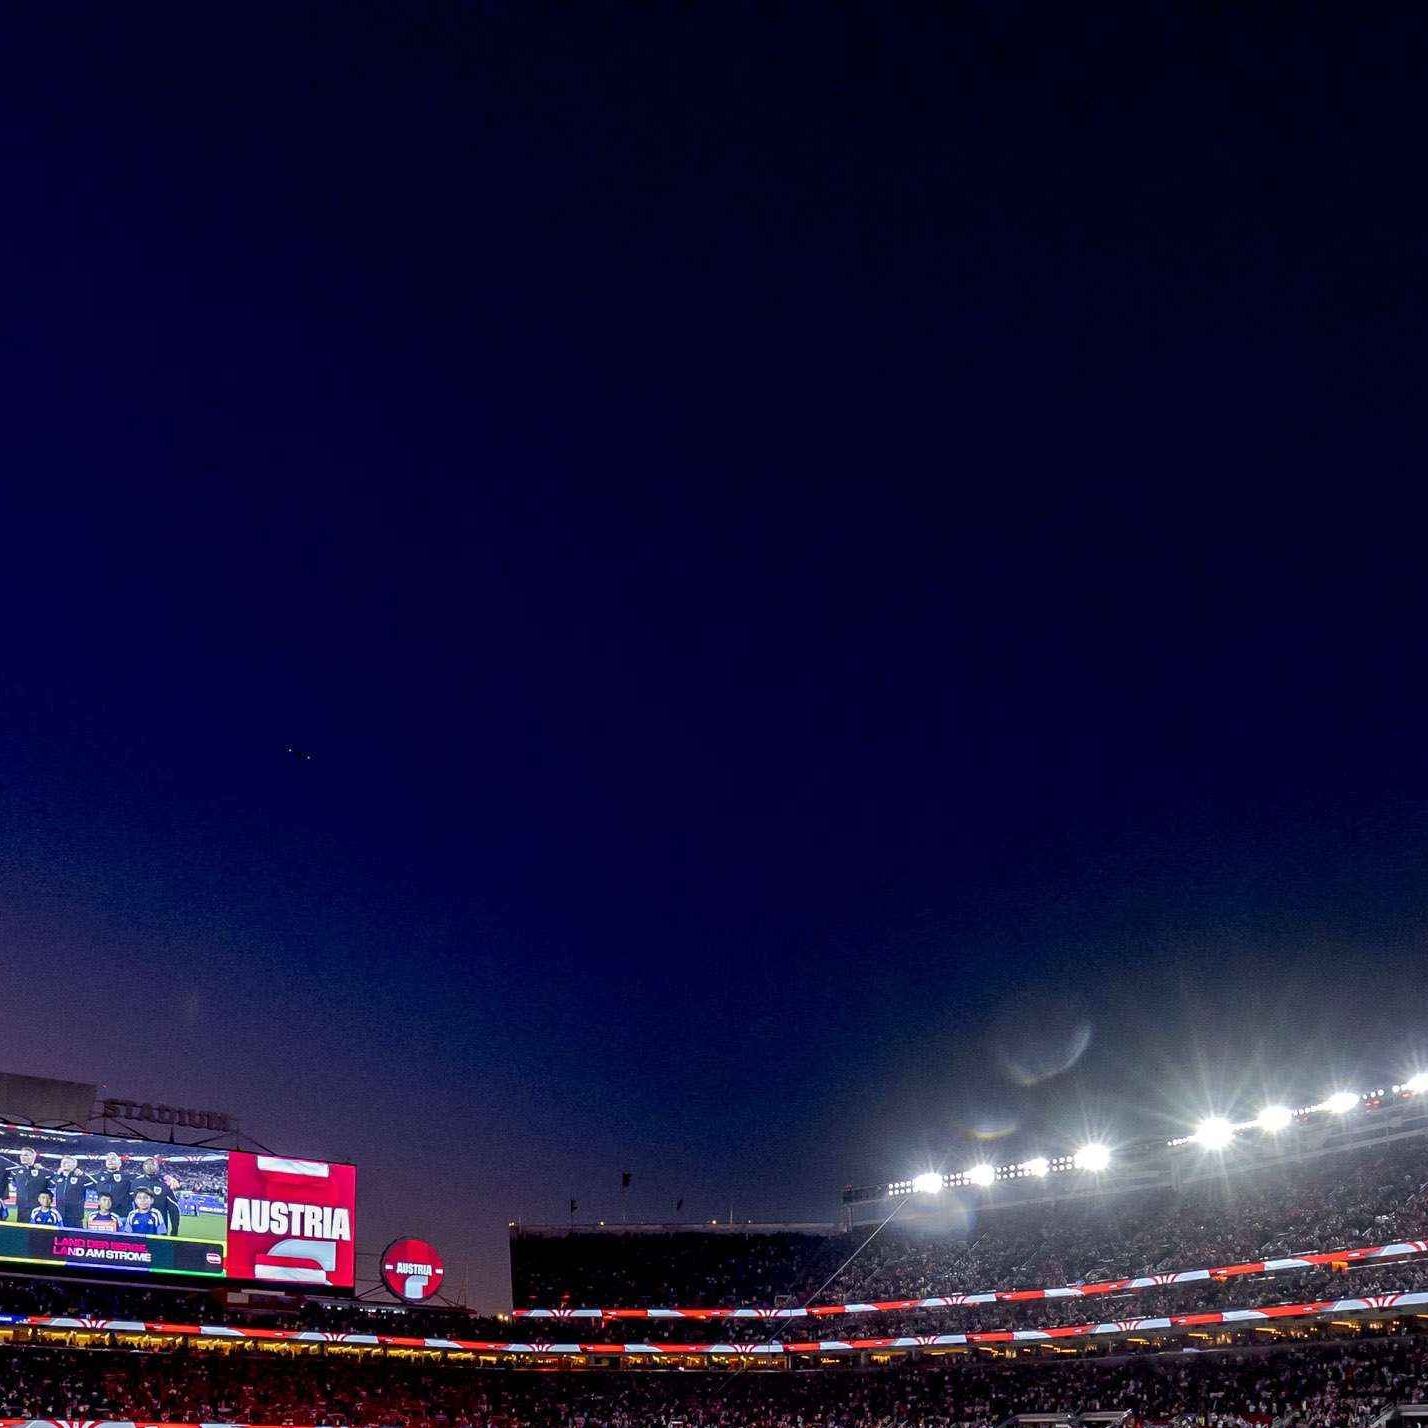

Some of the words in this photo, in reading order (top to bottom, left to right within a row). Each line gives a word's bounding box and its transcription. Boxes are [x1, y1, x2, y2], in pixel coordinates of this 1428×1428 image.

[230, 1197, 351, 1241] AUSTRIA
[53, 1246, 84, 1257] LAND
[86, 1248, 105, 1259] AM
[106, 1250, 152, 1262] STROME
[396, 1262, 432, 1277] AUSTRIA
